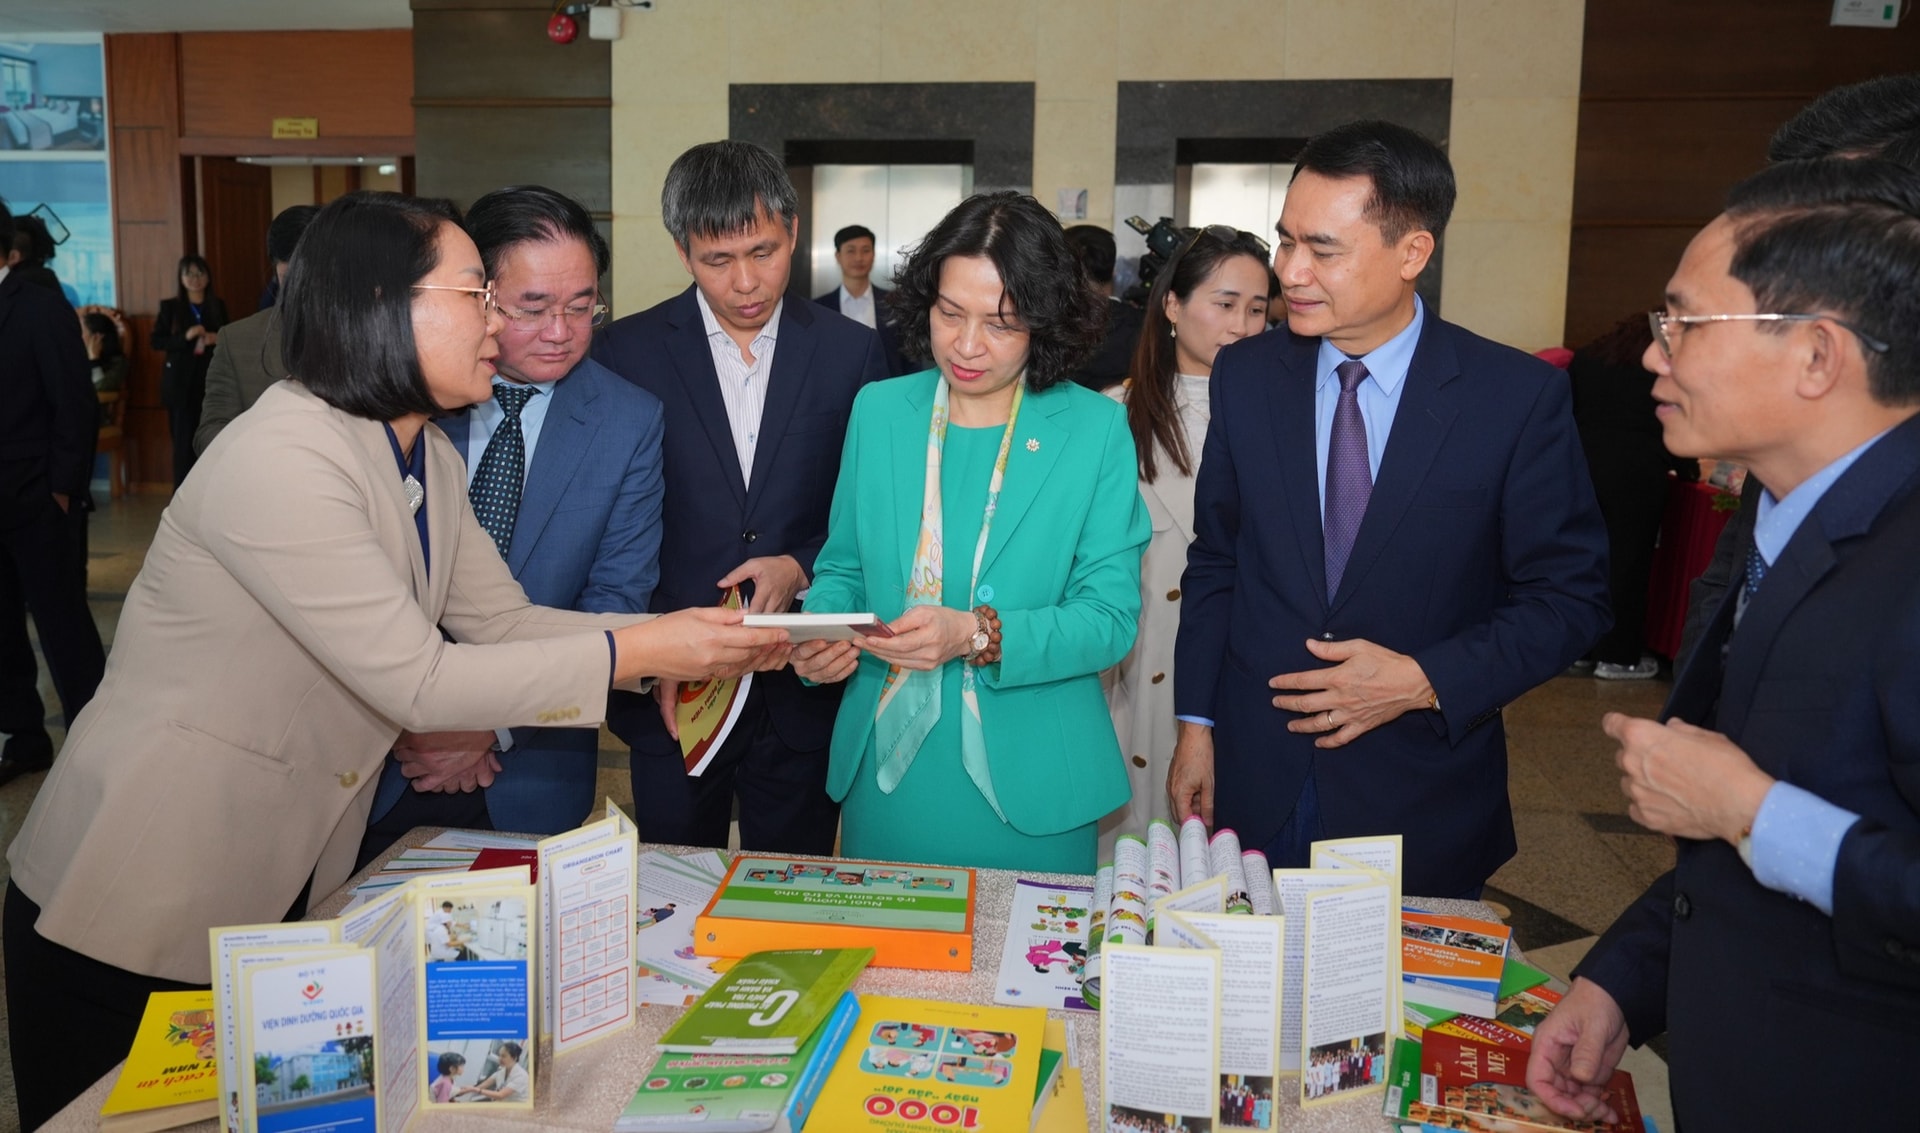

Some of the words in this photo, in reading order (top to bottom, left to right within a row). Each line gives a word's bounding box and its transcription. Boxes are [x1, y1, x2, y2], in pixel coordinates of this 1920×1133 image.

[261, 1017, 280, 1030] VIỆN
[281, 1014, 299, 1027] DINH
[300, 1009, 328, 1024] DƯỠNG
[329, 1006, 351, 1020] QUỐC
[351, 1004, 365, 1016] GIA
[161, 1062, 200, 1075] NAM
[1454, 1044, 1478, 1080] LÀM
[1487, 1050, 1510, 1076] MẸ
[163, 1071, 205, 1087] cách
[864, 1094, 980, 1130] 1000
